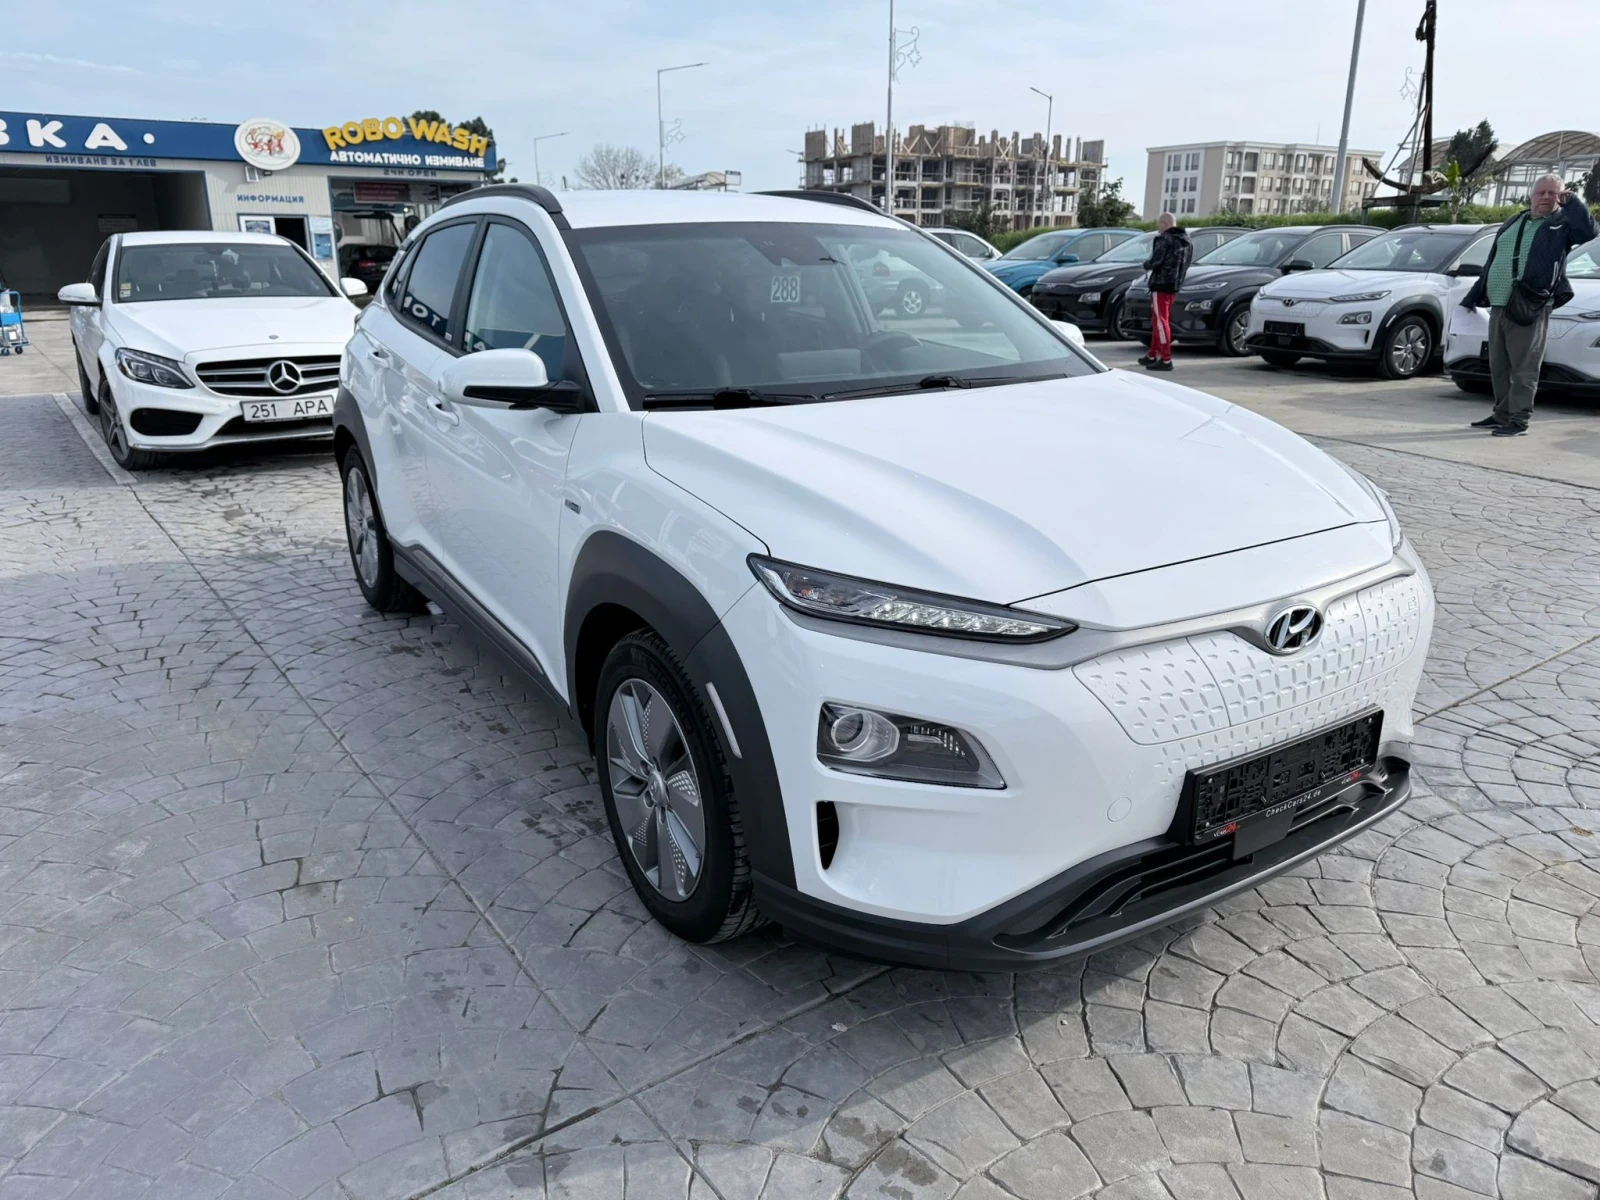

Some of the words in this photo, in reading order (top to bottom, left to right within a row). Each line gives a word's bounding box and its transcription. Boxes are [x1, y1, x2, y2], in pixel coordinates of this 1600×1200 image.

[0, 118, 128, 151] КА
[322, 116, 405, 150] ROBO
[408, 117, 489, 157] WASH
[45, 155, 107, 166] ИЗМИВАНЕ
[111, 157, 126, 167] ЗА
[134, 158, 157, 167] ЛЕВ
[330, 150, 421, 166] АВТОМАТИЧНО
[425, 154, 485, 168] ИЗМИВАНЕ
[237, 194, 304, 204] ИНФОРМАЦИЯ
[771, 277, 798, 302] 288
[250, 403, 277, 419] 251
[293, 399, 329, 416] APA
[1265, 788, 1322, 818] CheckCars24.de
